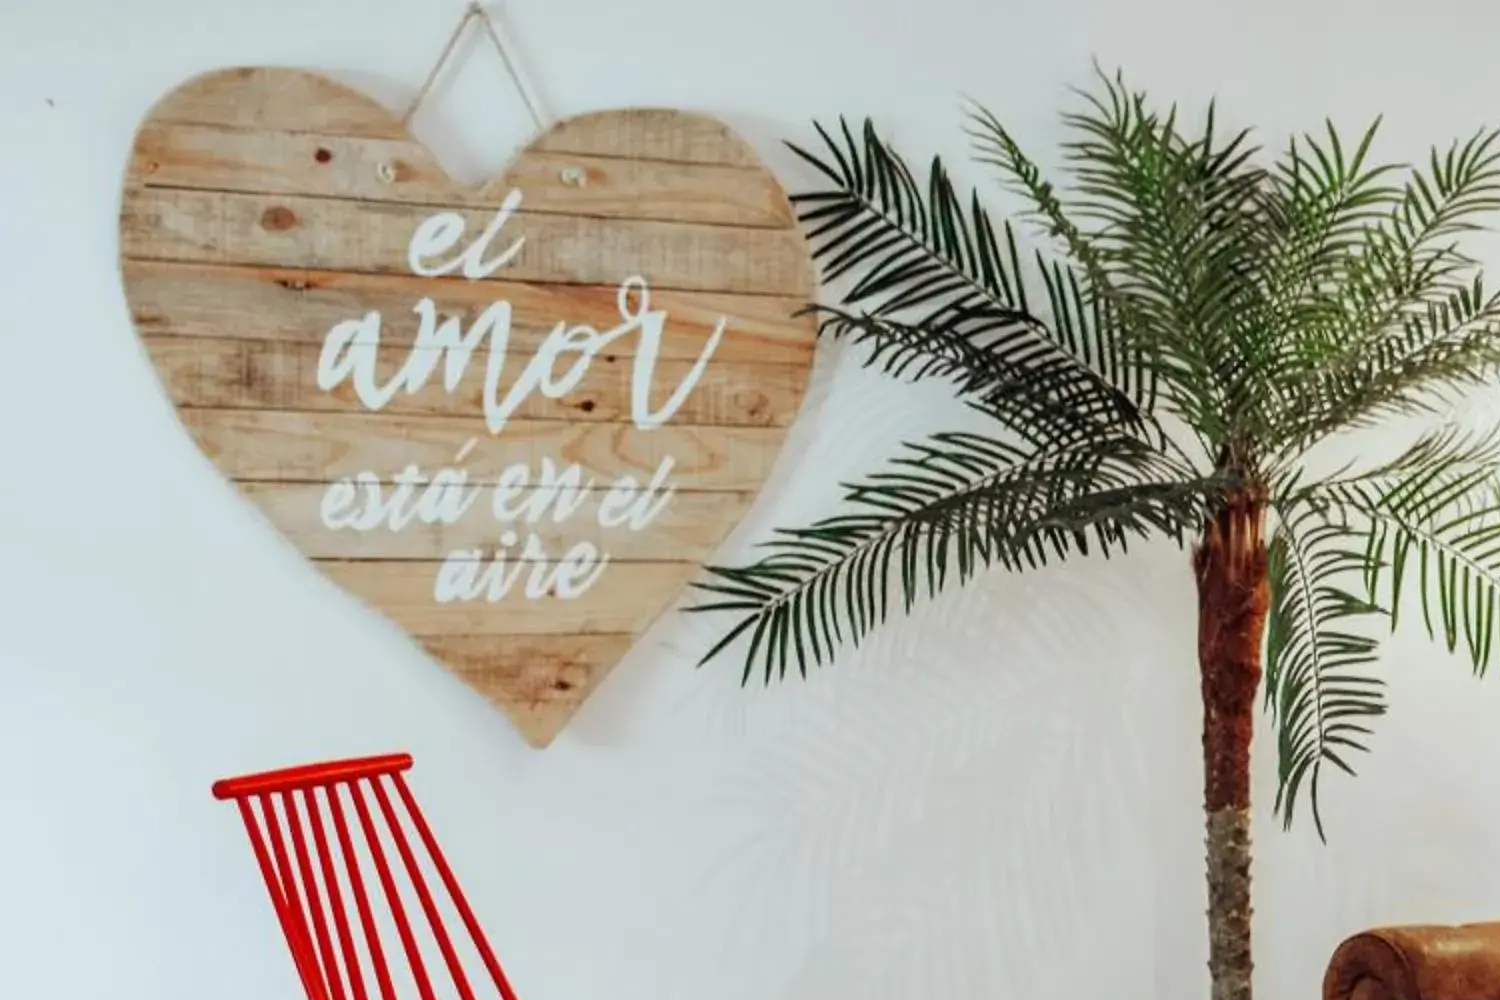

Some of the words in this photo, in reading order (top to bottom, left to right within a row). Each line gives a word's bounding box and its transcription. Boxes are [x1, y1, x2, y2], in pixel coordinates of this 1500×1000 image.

[408, 188, 526, 279] el
[316, 275, 726, 434] amor
[320, 438, 479, 532] está
[492, 456, 596, 524] en
[597, 455, 677, 531] el
[434, 530, 610, 603] aire
